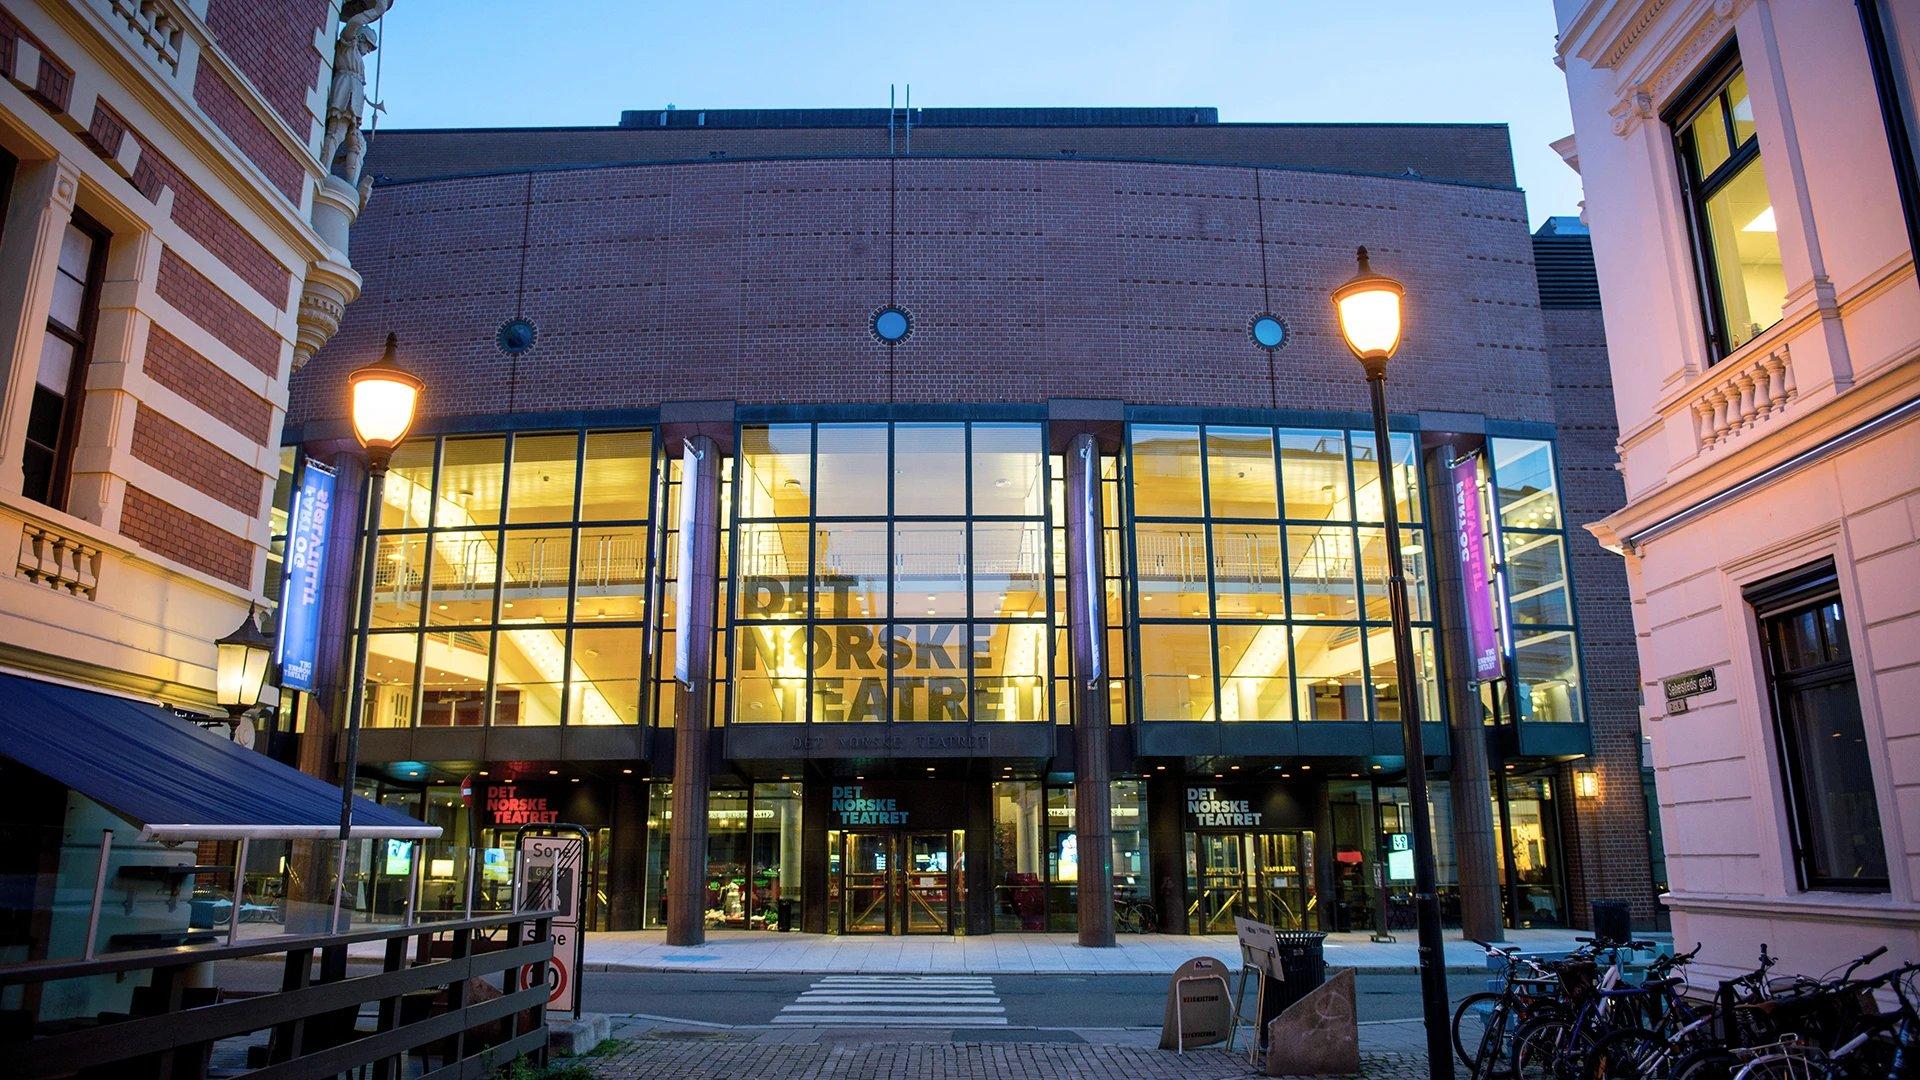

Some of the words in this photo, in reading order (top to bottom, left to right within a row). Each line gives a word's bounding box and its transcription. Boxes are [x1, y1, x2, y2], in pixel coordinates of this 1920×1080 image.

[743, 575, 859, 619] DET
[741, 624, 992, 670] NORSKE
[1668, 679, 1697, 695] Sehesteds
[1699, 675, 1712, 691] gate
[792, 736, 824, 749] DET
[838, 736, 903, 749] NORSKE
[913, 736, 988, 749] TEATRET
[488, 786, 517, 799] DET
[832, 786, 863, 799] DET
[1187, 788, 1217, 800] DET
[487, 798, 547, 811] NORSKE
[832, 799, 896, 811] NORSKE
[1188, 800, 1249, 813] NORSKE
[494, 811, 558, 824] TEATRET
[840, 811, 909, 824] TEATRET
[1196, 813, 1262, 826] TEATRET
[533, 842, 570, 858] Sone
[527, 929, 566, 945] Sne
